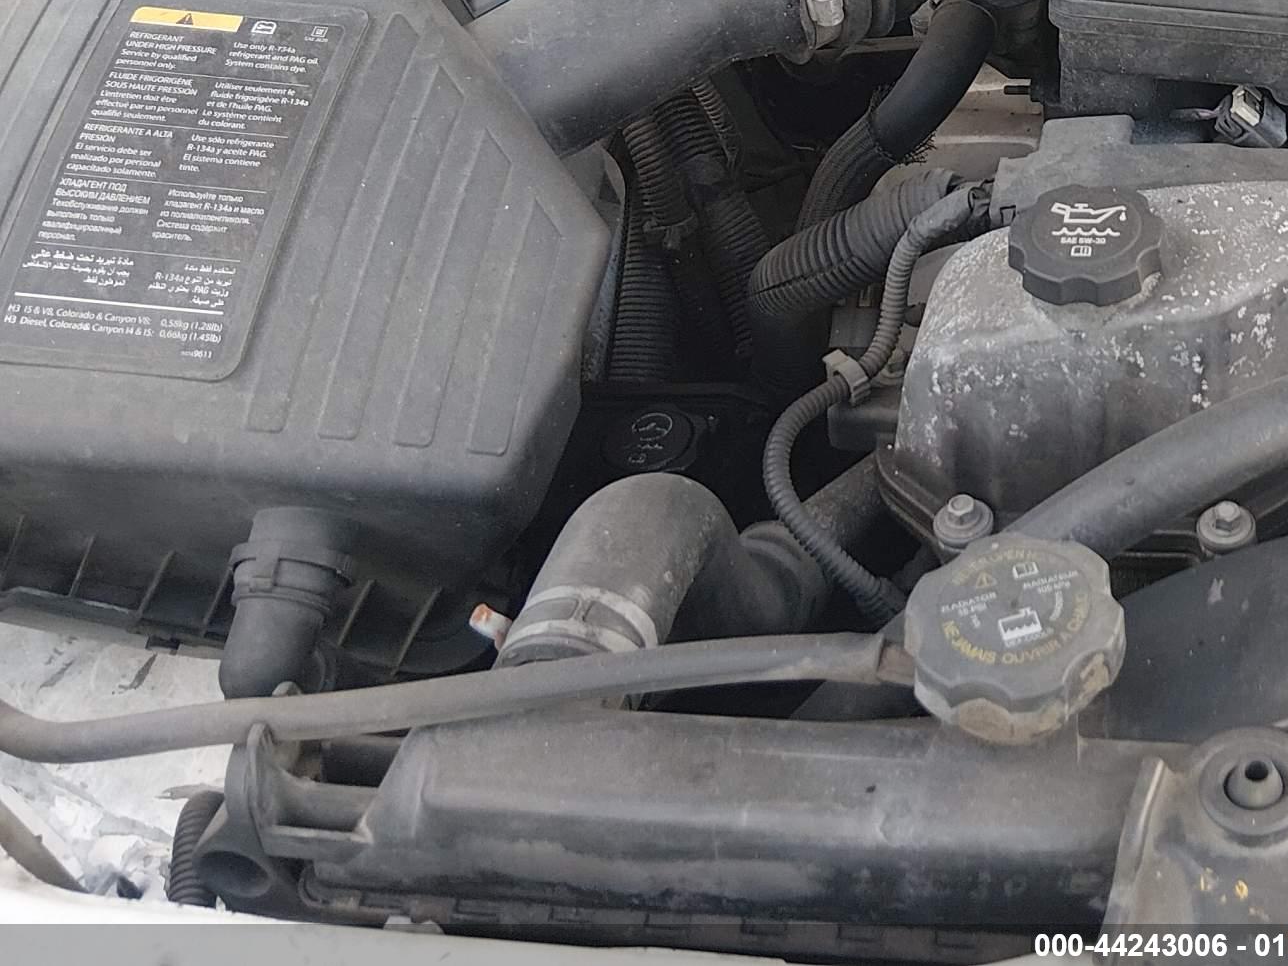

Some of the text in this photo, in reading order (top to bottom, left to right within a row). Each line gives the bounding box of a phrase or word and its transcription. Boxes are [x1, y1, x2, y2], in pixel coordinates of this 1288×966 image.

[129, 31, 185, 42] REFRIGERANT
[125, 40, 218, 55] UNDER HIGH PRESSURE
[233, 41, 248, 49] Use
[249, 43, 267, 52] only
[120, 48, 198, 62] Service by qualified
[229, 51, 271, 61] refrigerant
[272, 53, 288, 62] and
[288, 56, 306, 64] PAG
[115, 58, 157, 68] personnel
[225, 59, 254, 68] System
[254, 62, 289, 71] contains
[109, 71, 139, 81] FLUIDE
[105, 81, 198, 96] SOUS HAUTE PRESSION
[215, 82, 243, 90] Utiliser
[244, 86, 287, 95] seulement
[143, 94, 160, 102] doit
[210, 90, 234, 99] fluide
[281, 97, 309, 107] R-134a
[156, 106, 199, 115] personnel
[248, 114, 282, 123] contient
[152, 129, 173, 138] ALTA
[191, 134, 207, 142] Use
[226, 139, 275, 148] refrigerante
[75, 142, 84, 150] El
[84, 145, 116, 153] servicio
[117, 147, 138, 155] debe
[187, 144, 215, 153] R-134a
[222, 148, 248, 156] aceite
[124, 158, 161, 168] personal
[192, 155, 222, 164] sistema
[224, 158, 261, 167] contiene
[66, 163, 111, 173] capacitado
[8, 303, 21, 313] H3
[33, 306, 40, 314] &
[56, 308, 95, 320] Colorado
[96, 312, 103, 320] &
[104, 313, 136, 324] Canyon
[4, 315, 17, 324] H3
[92, 324, 124, 335] Canyon
